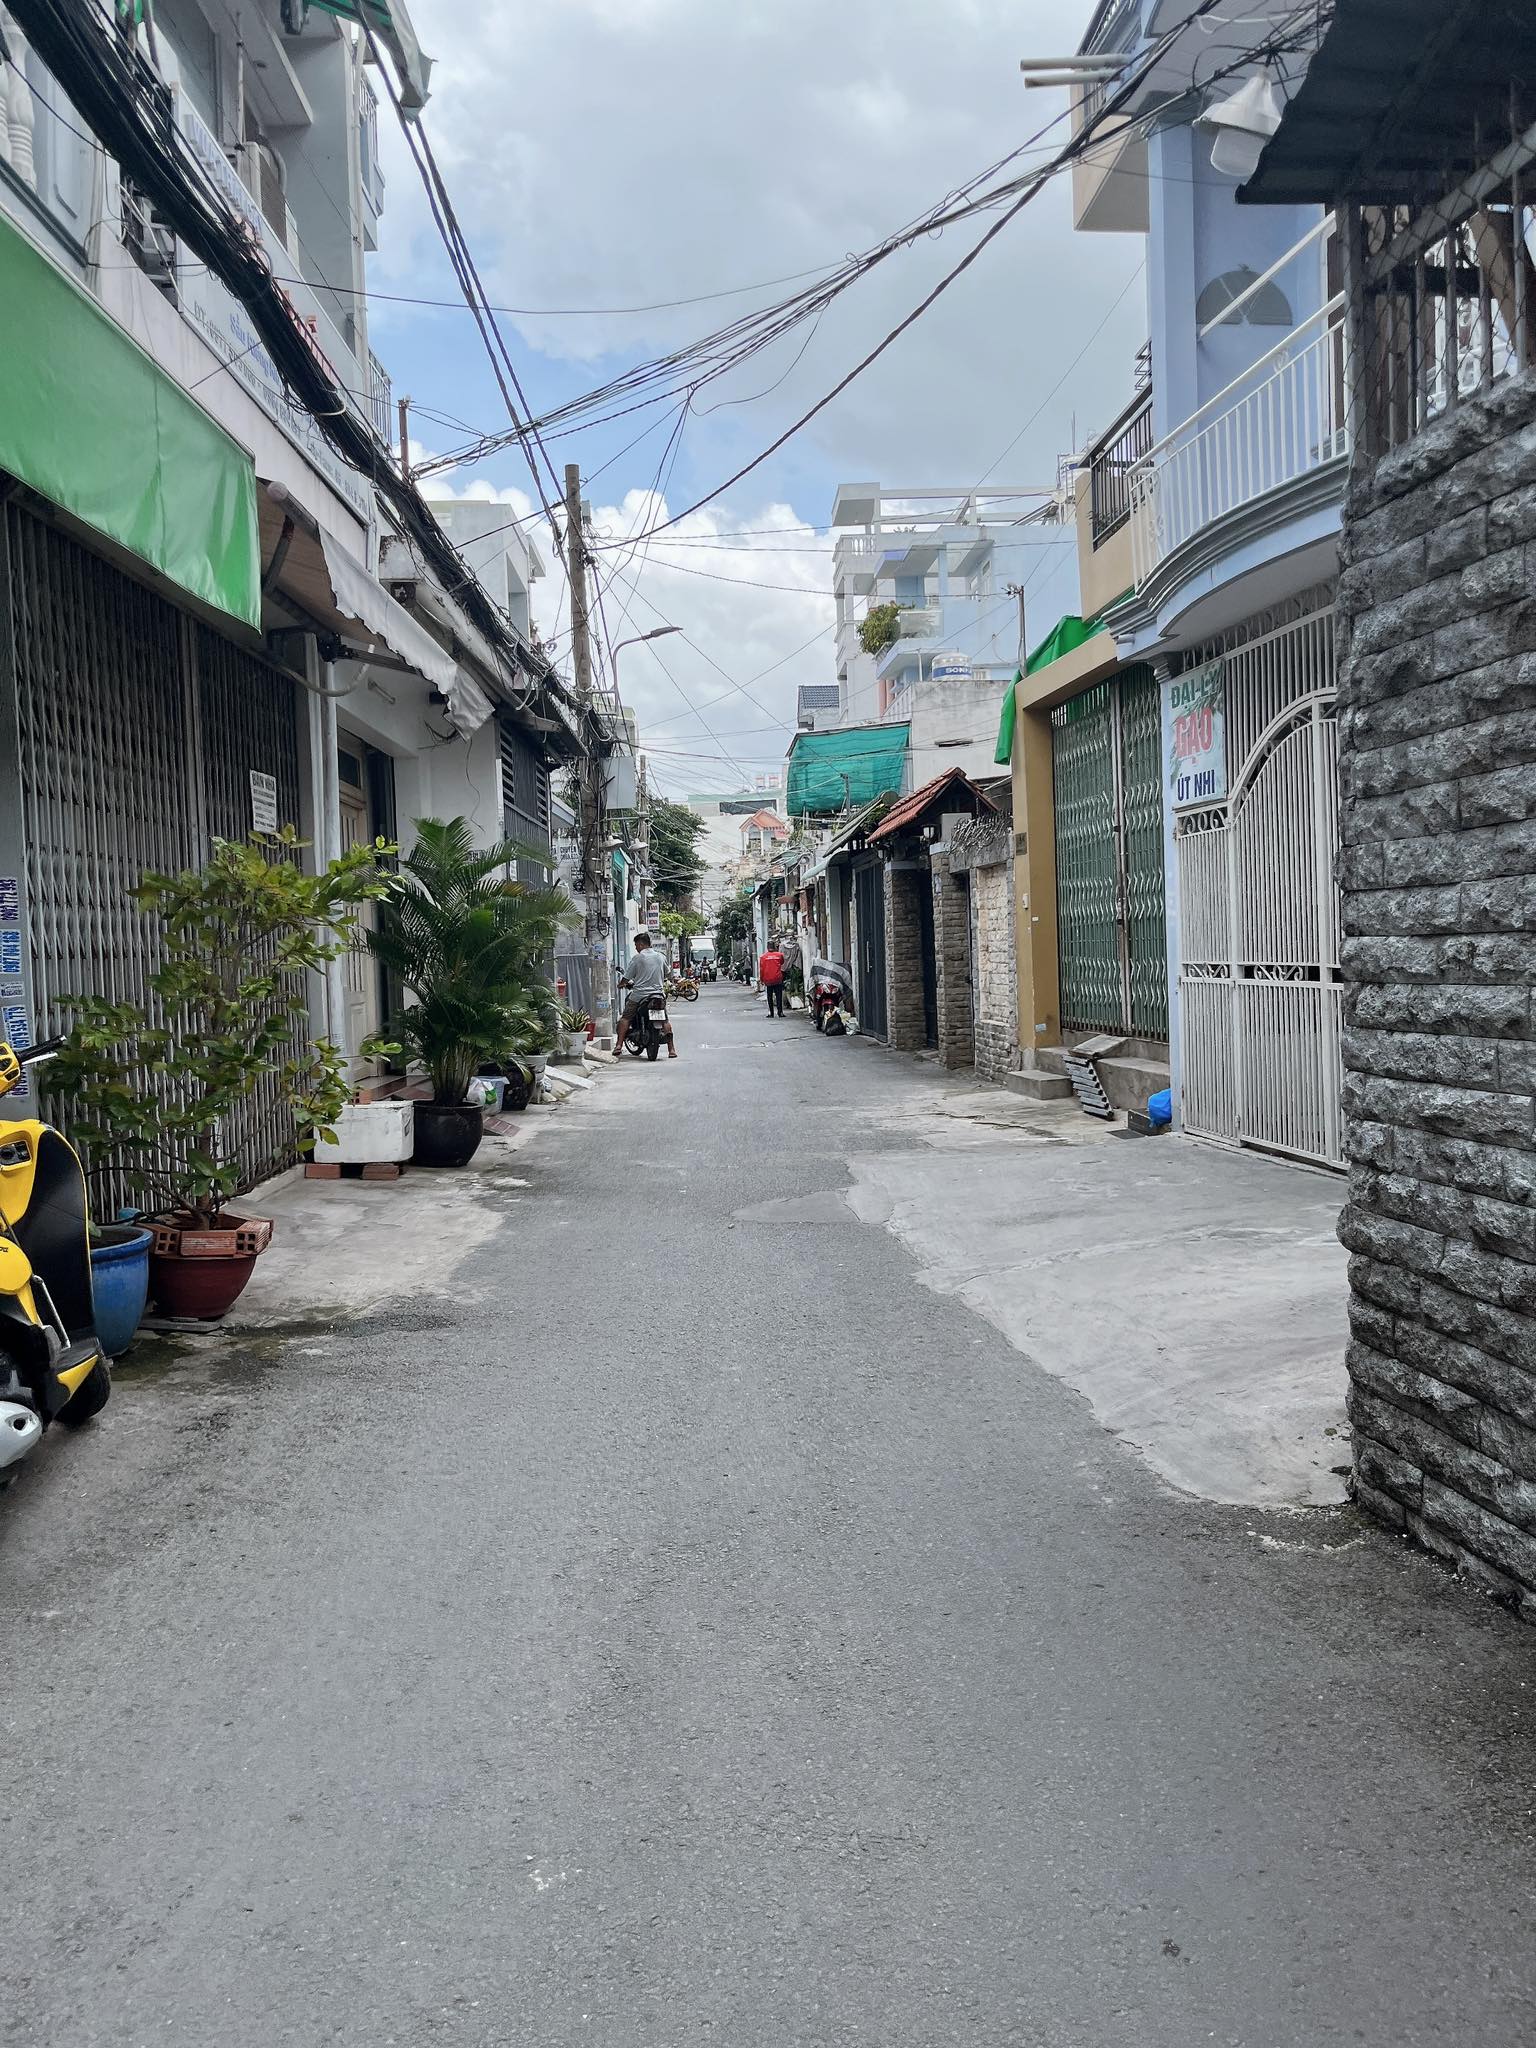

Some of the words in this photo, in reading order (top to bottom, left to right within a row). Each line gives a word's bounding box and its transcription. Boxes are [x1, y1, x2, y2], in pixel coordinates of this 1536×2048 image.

[1176, 707, 1212, 765] GẠO
[1177, 773, 1191, 801] ÚT
[1194, 769, 1215, 798] NHI
